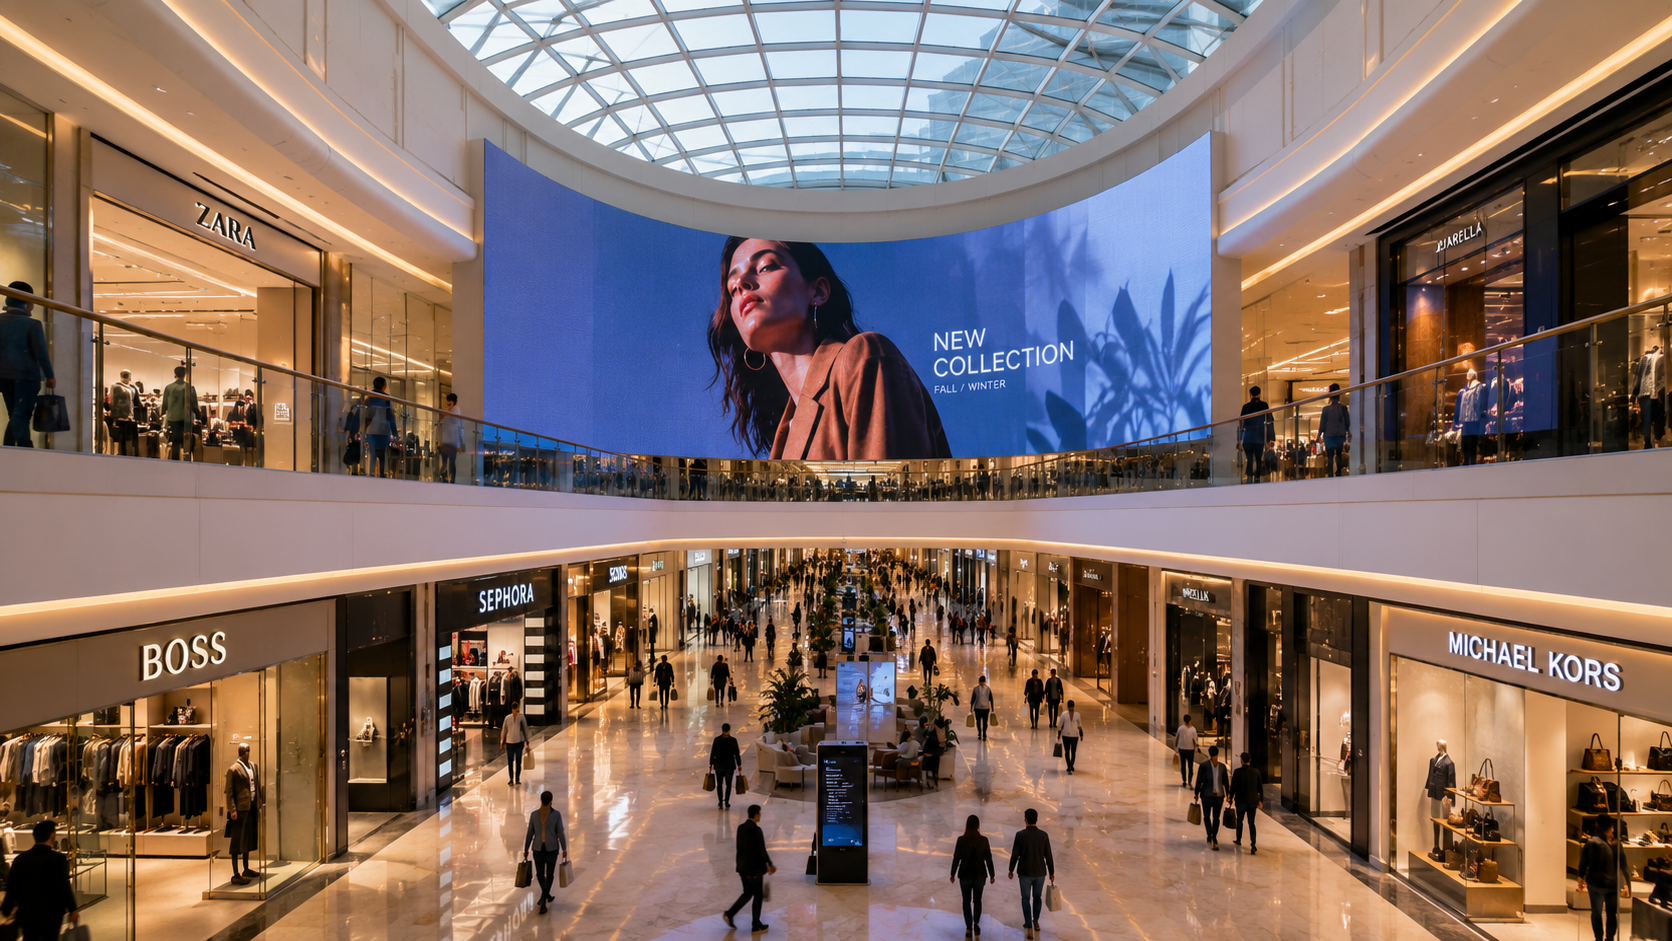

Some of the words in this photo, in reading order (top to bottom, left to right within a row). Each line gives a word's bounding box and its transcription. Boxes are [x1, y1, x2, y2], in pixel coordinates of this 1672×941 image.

[195, 202, 256, 252] ZARA
[933, 340, 1074, 377] COLLECTION
[934, 328, 986, 352] NEW
[934, 384, 957, 394] FALL
[968, 379, 1006, 391] WINTER
[479, 582, 534, 613] SEPHORA
[140, 631, 226, 681] BOSS
[1449, 631, 1541, 674] MICHAEL
[1548, 651, 1623, 692] KORS
